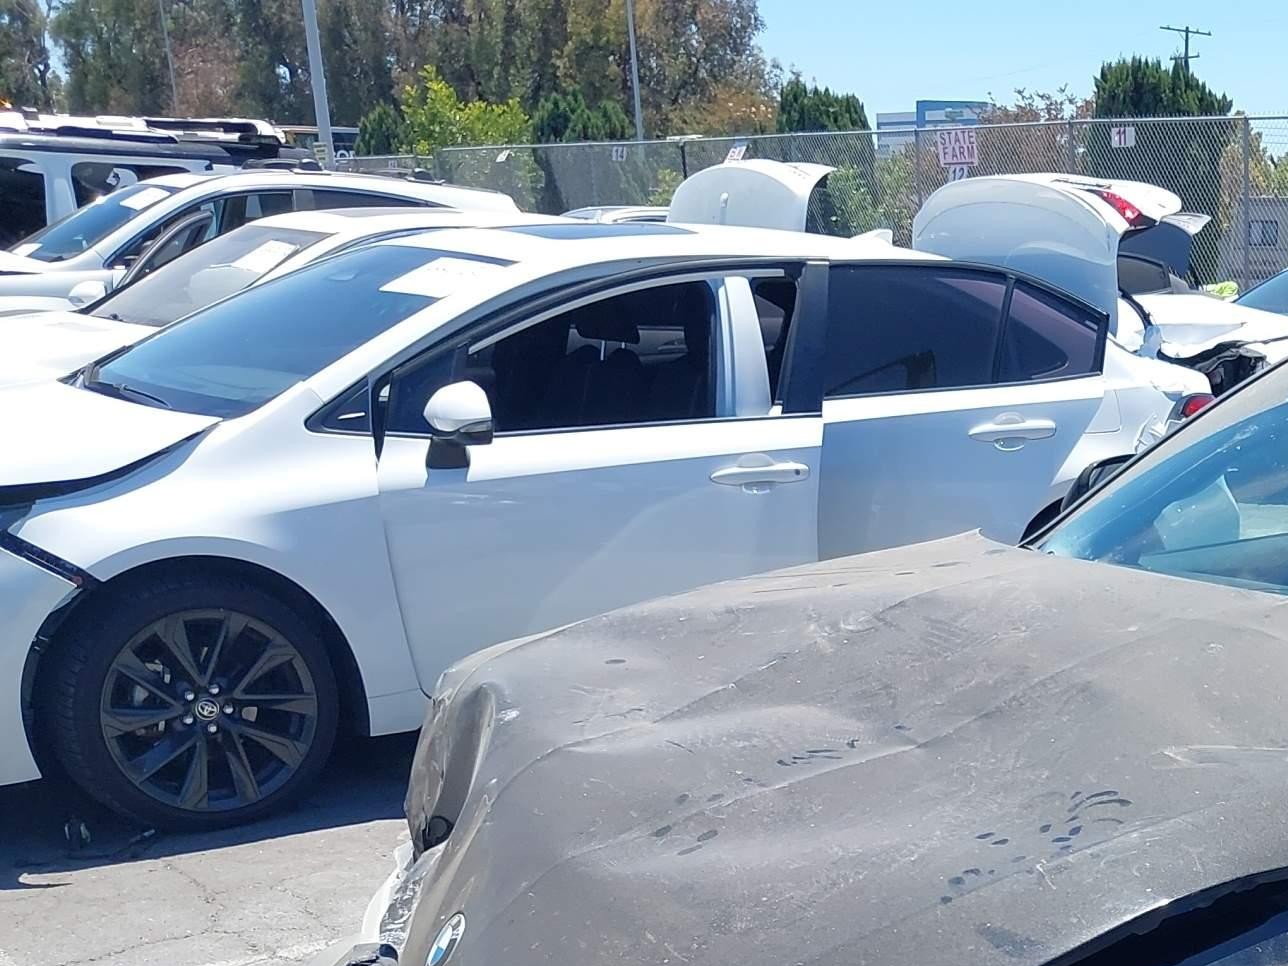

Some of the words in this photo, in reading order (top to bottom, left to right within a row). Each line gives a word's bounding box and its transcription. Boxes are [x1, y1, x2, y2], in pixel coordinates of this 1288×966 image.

[940, 130, 976, 146] STATE
[1115, 128, 1127, 146] 11
[943, 144, 976, 161] FARM
[951, 166, 966, 180] 12
